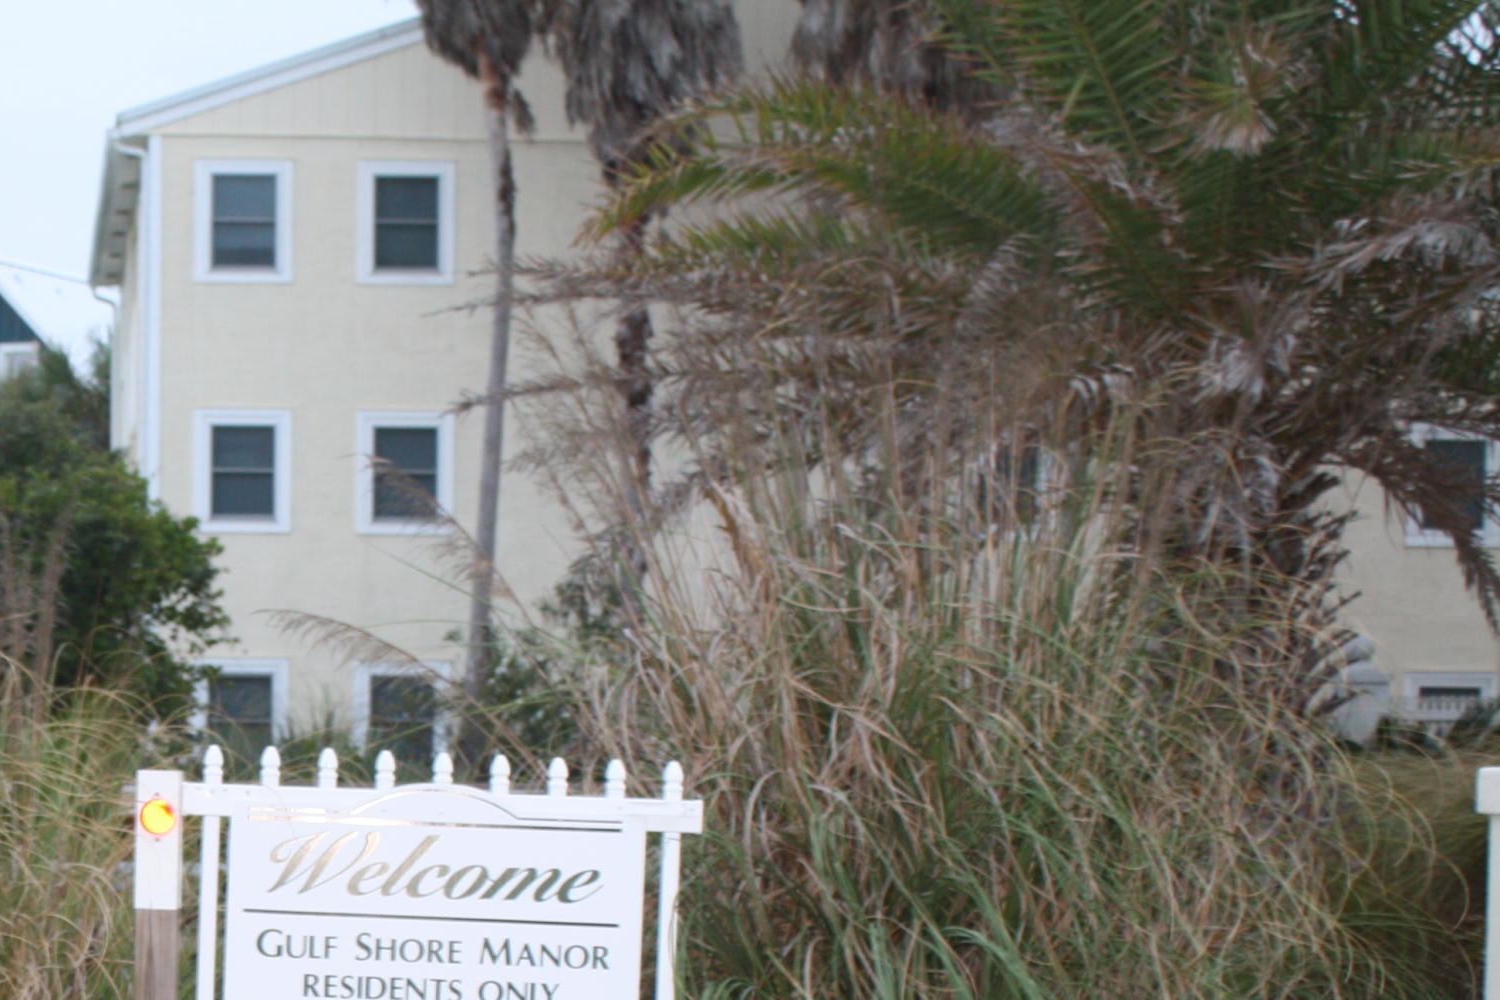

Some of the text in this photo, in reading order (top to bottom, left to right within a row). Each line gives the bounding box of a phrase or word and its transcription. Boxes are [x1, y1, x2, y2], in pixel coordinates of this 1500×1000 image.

[267, 831, 604, 903] Welcome
[256, 929, 609, 970] GULF SHORE MANOR
